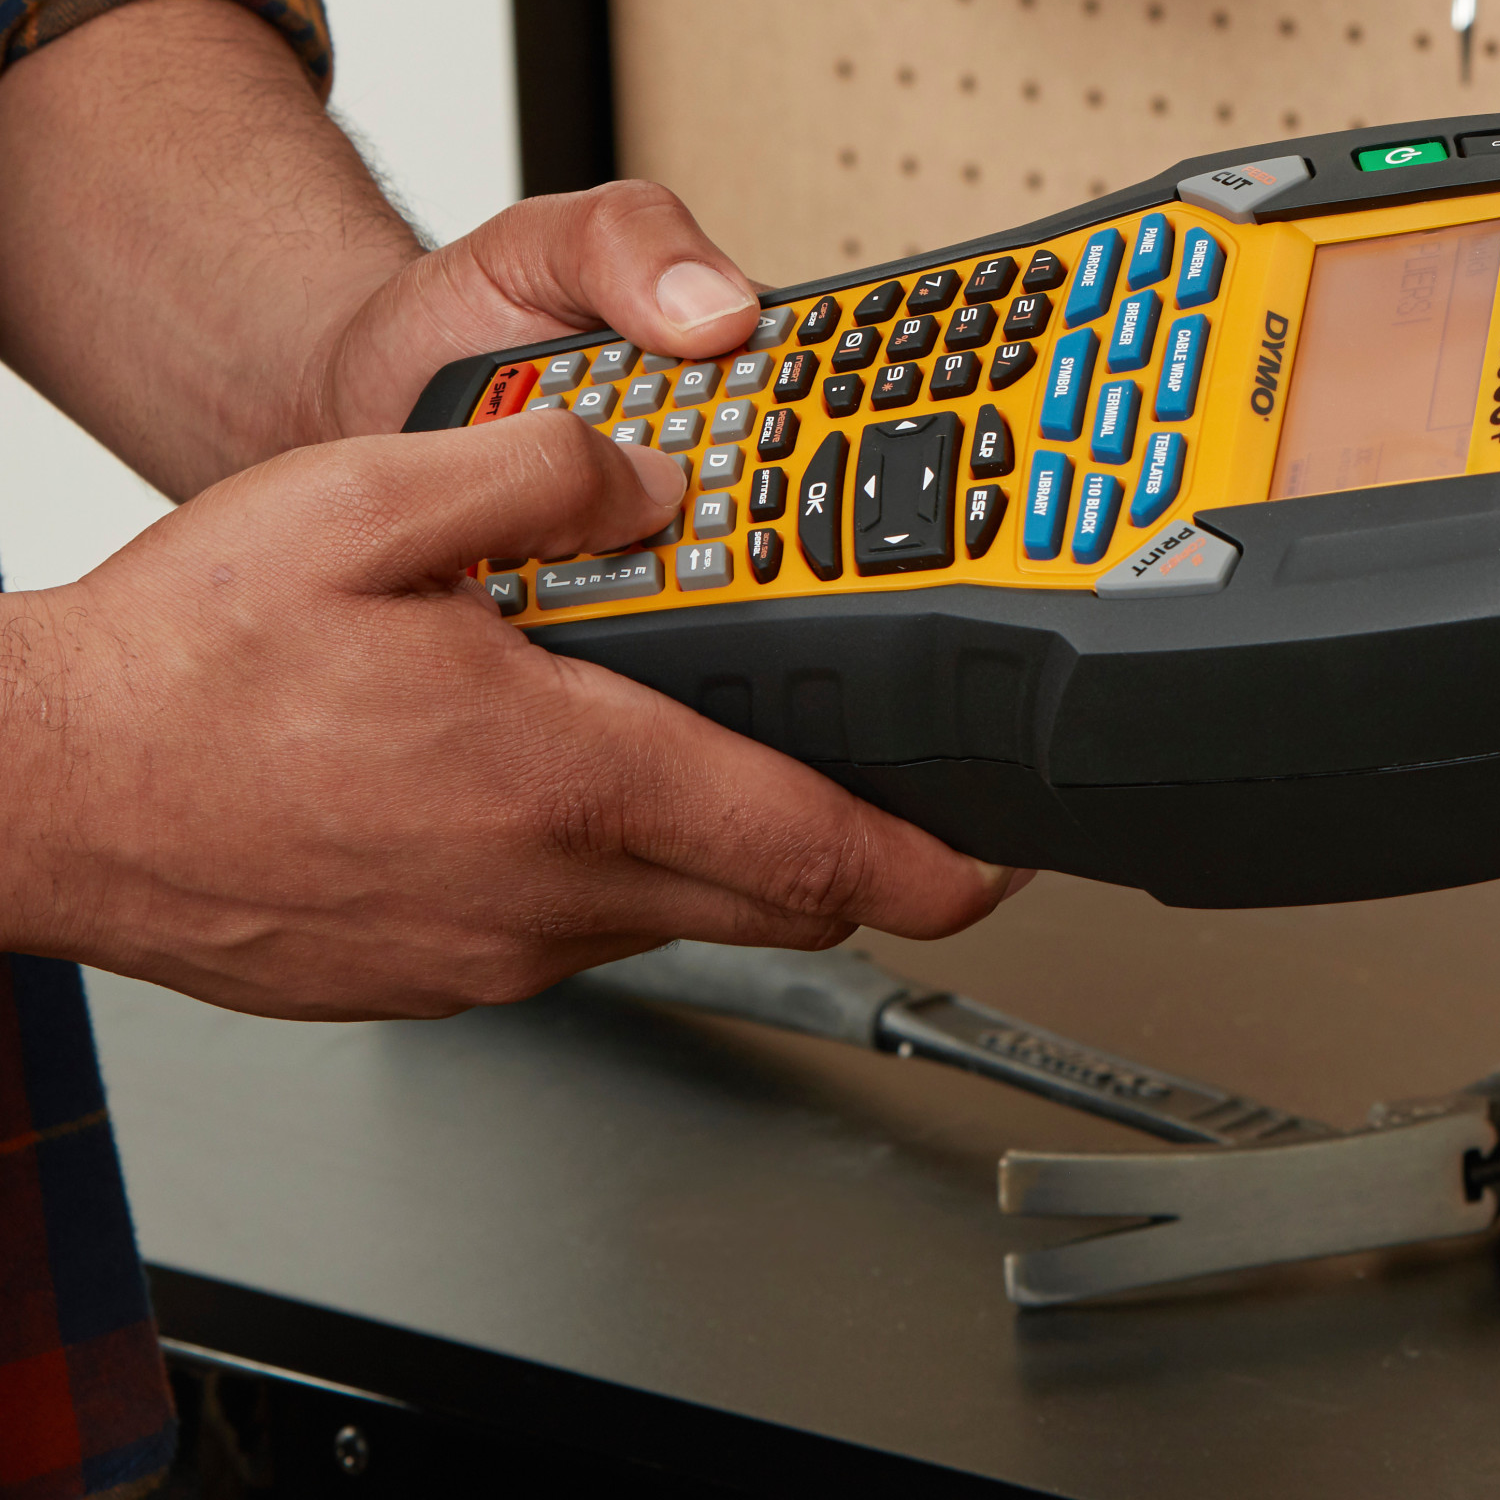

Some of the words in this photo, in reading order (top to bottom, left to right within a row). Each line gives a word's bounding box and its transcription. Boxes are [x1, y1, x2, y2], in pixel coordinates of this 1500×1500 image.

[1211, 171, 1253, 190] CUT
[1241, 166, 1277, 186] FEED
[1139, 227, 1158, 255] PANEL
[980, 261, 998, 275] 4
[1080, 245, 1103, 287] BARCODE
[1187, 239, 1209, 280] GENERAL
[925, 275, 942, 287] 7
[1017, 298, 1035, 313] 2
[758, 316, 776, 328] A
[903, 319, 921, 334] 8
[1118, 302, 1141, 346] BREAKER
[1002, 344, 1020, 359] 3
[1173, 329, 1191, 361] CABLE
[604, 351, 621, 362] P
[1250, 310, 1289, 416] DYMO
[551, 361, 570, 373] U
[736, 362, 755, 375] B
[684, 371, 703, 385] G
[1054, 357, 1074, 398] SYMBOL
[1167, 362, 1185, 392] WRAP
[486, 381, 507, 416] SHIFT
[633, 384, 652, 395] L
[580, 392, 600, 407] Q
[721, 407, 739, 421] C
[1100, 386, 1122, 438] TERMINAL
[667, 418, 688, 431] H
[615, 427, 635, 442] M
[979, 431, 997, 458] CLR
[709, 453, 728, 467] D
[1145, 434, 1171, 494] TEMPLATES
[1033, 470, 1053, 516] LIBRARY
[1087, 476, 1103, 497] 110
[805, 482, 827, 516] OK
[969, 490, 987, 521] ESC
[701, 502, 720, 516] E
[1081, 498, 1100, 534] BLOCK
[1131, 526, 1196, 577] PRINT
[490, 583, 510, 596] Z
